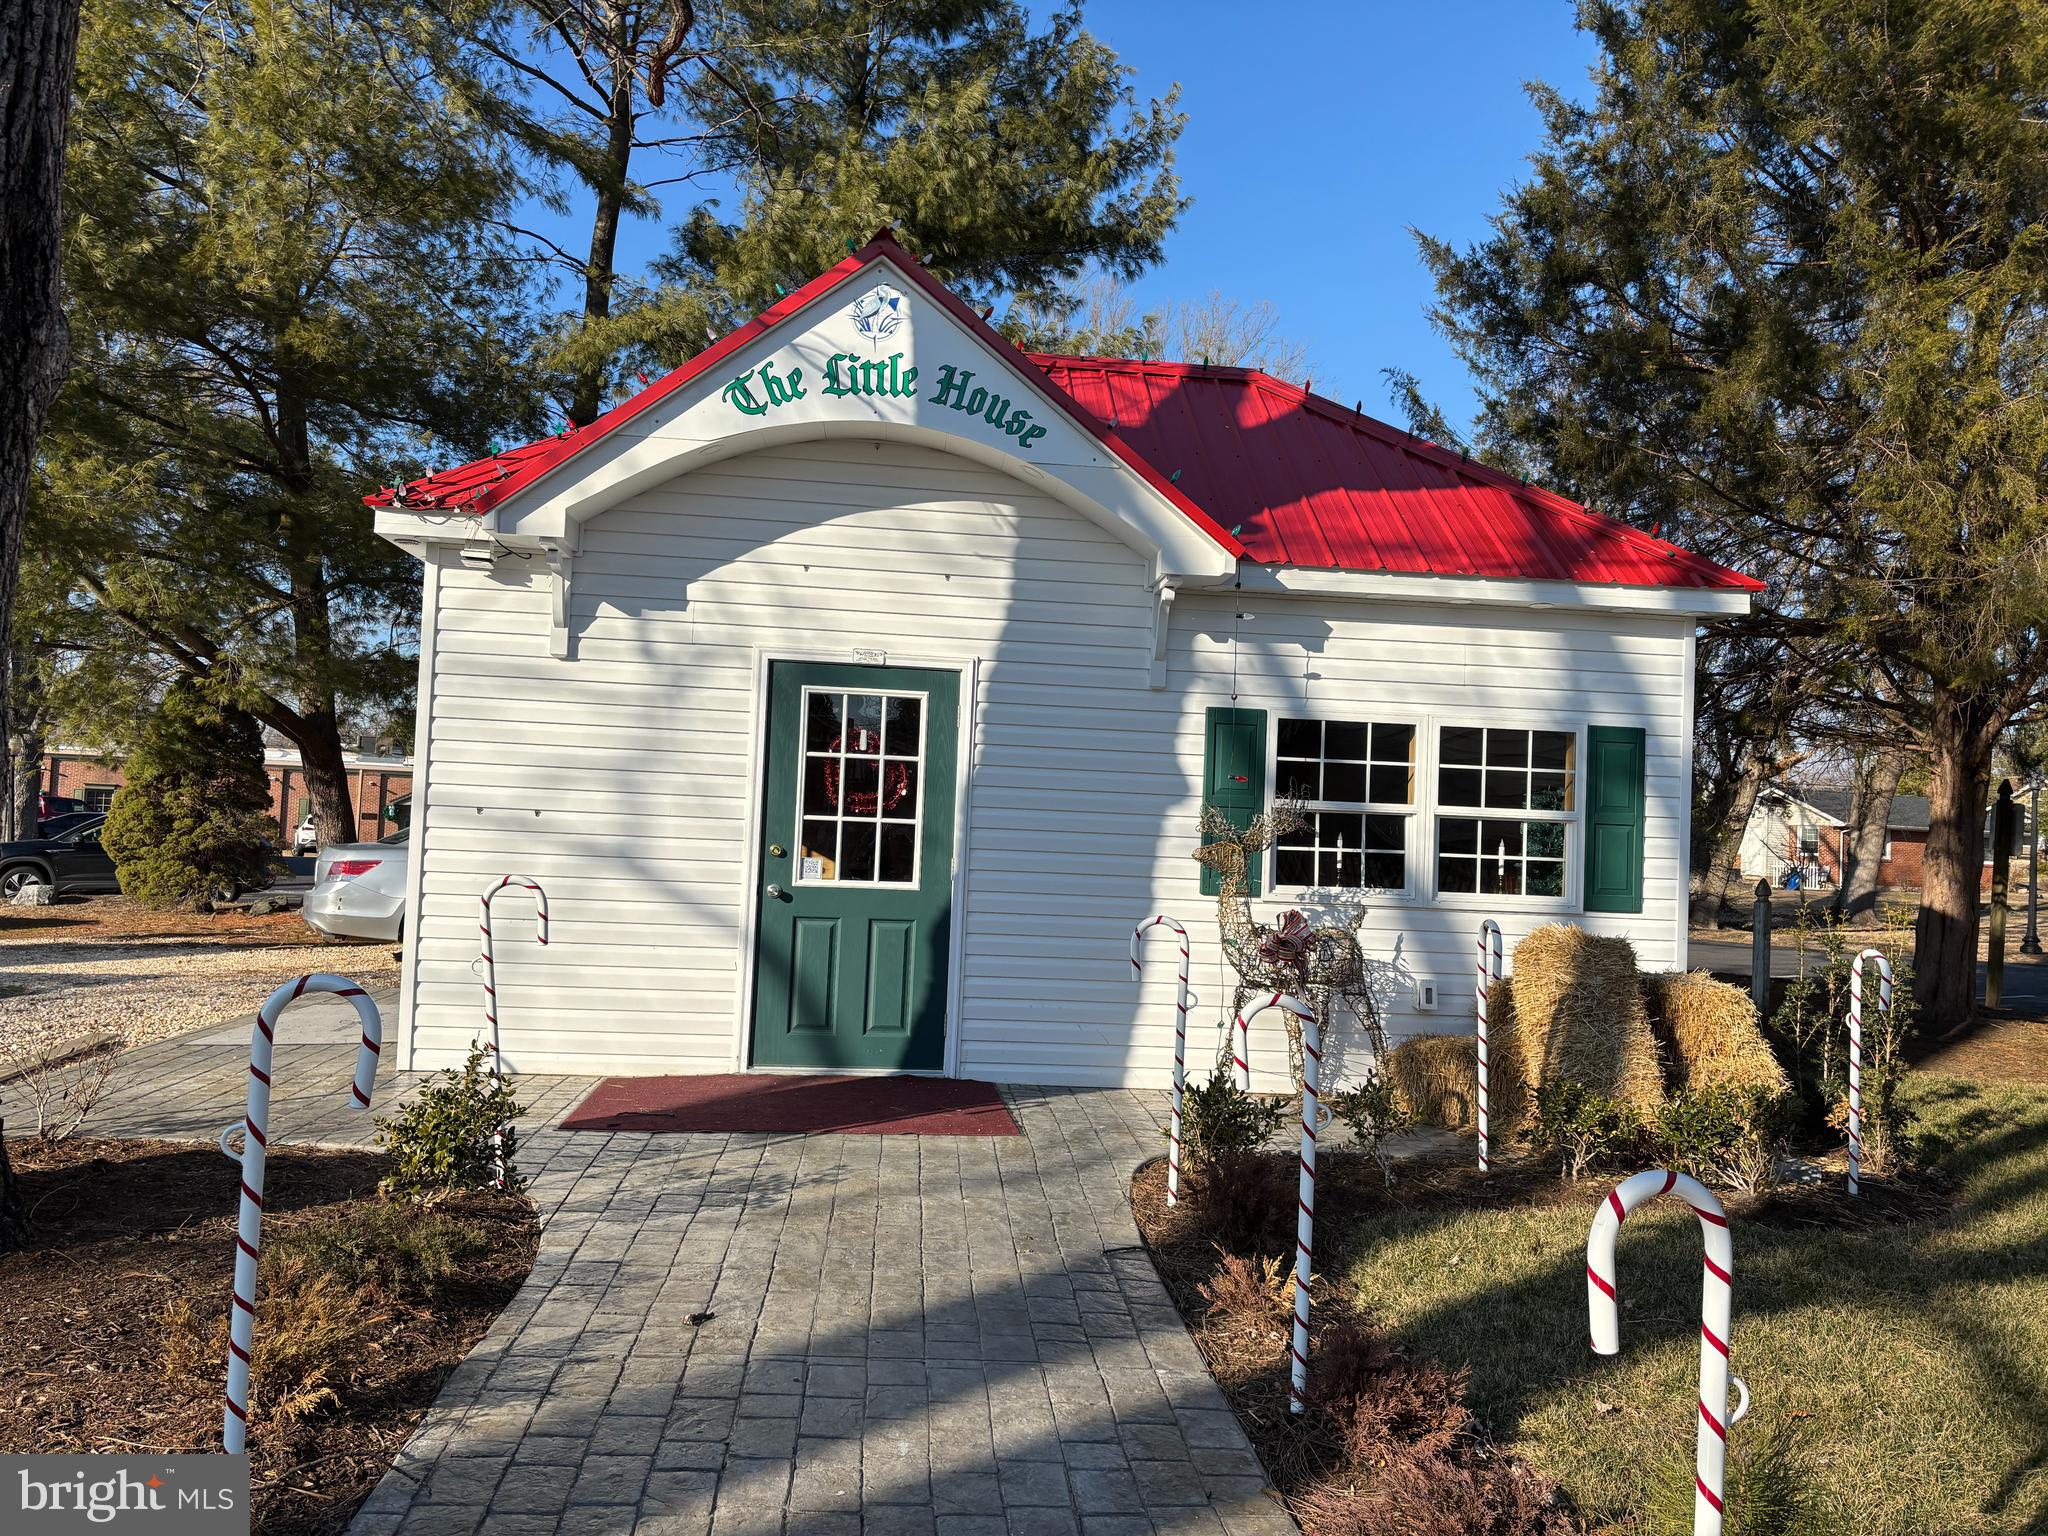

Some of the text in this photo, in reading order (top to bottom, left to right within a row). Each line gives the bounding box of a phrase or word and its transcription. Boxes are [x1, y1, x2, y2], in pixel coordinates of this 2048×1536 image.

[722, 352, 1048, 449] The Little House
